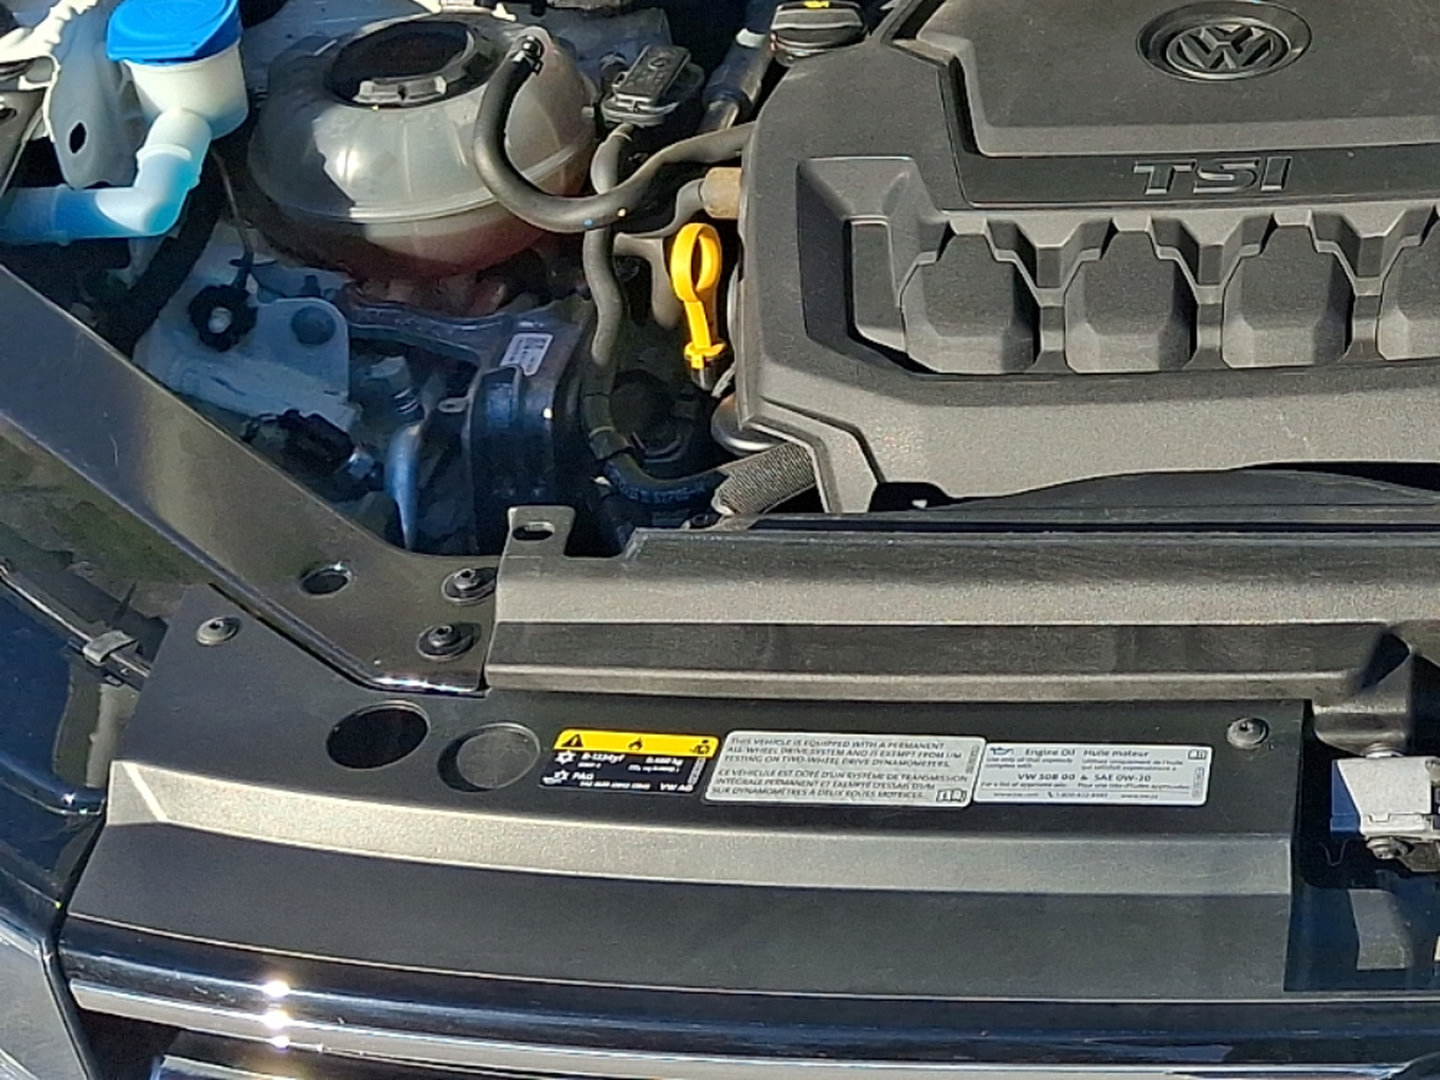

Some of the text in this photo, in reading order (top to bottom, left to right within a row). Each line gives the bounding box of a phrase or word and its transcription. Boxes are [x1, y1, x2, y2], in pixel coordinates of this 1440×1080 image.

[1167, 17, 1290, 79] VW
[1133, 156, 1292, 195] TSI
[1025, 748, 1076, 757] Engine Oil
[1083, 749, 1150, 757] Huile moteur
[571, 772, 595, 781] PAG
[660, 782, 676, 792] VW
